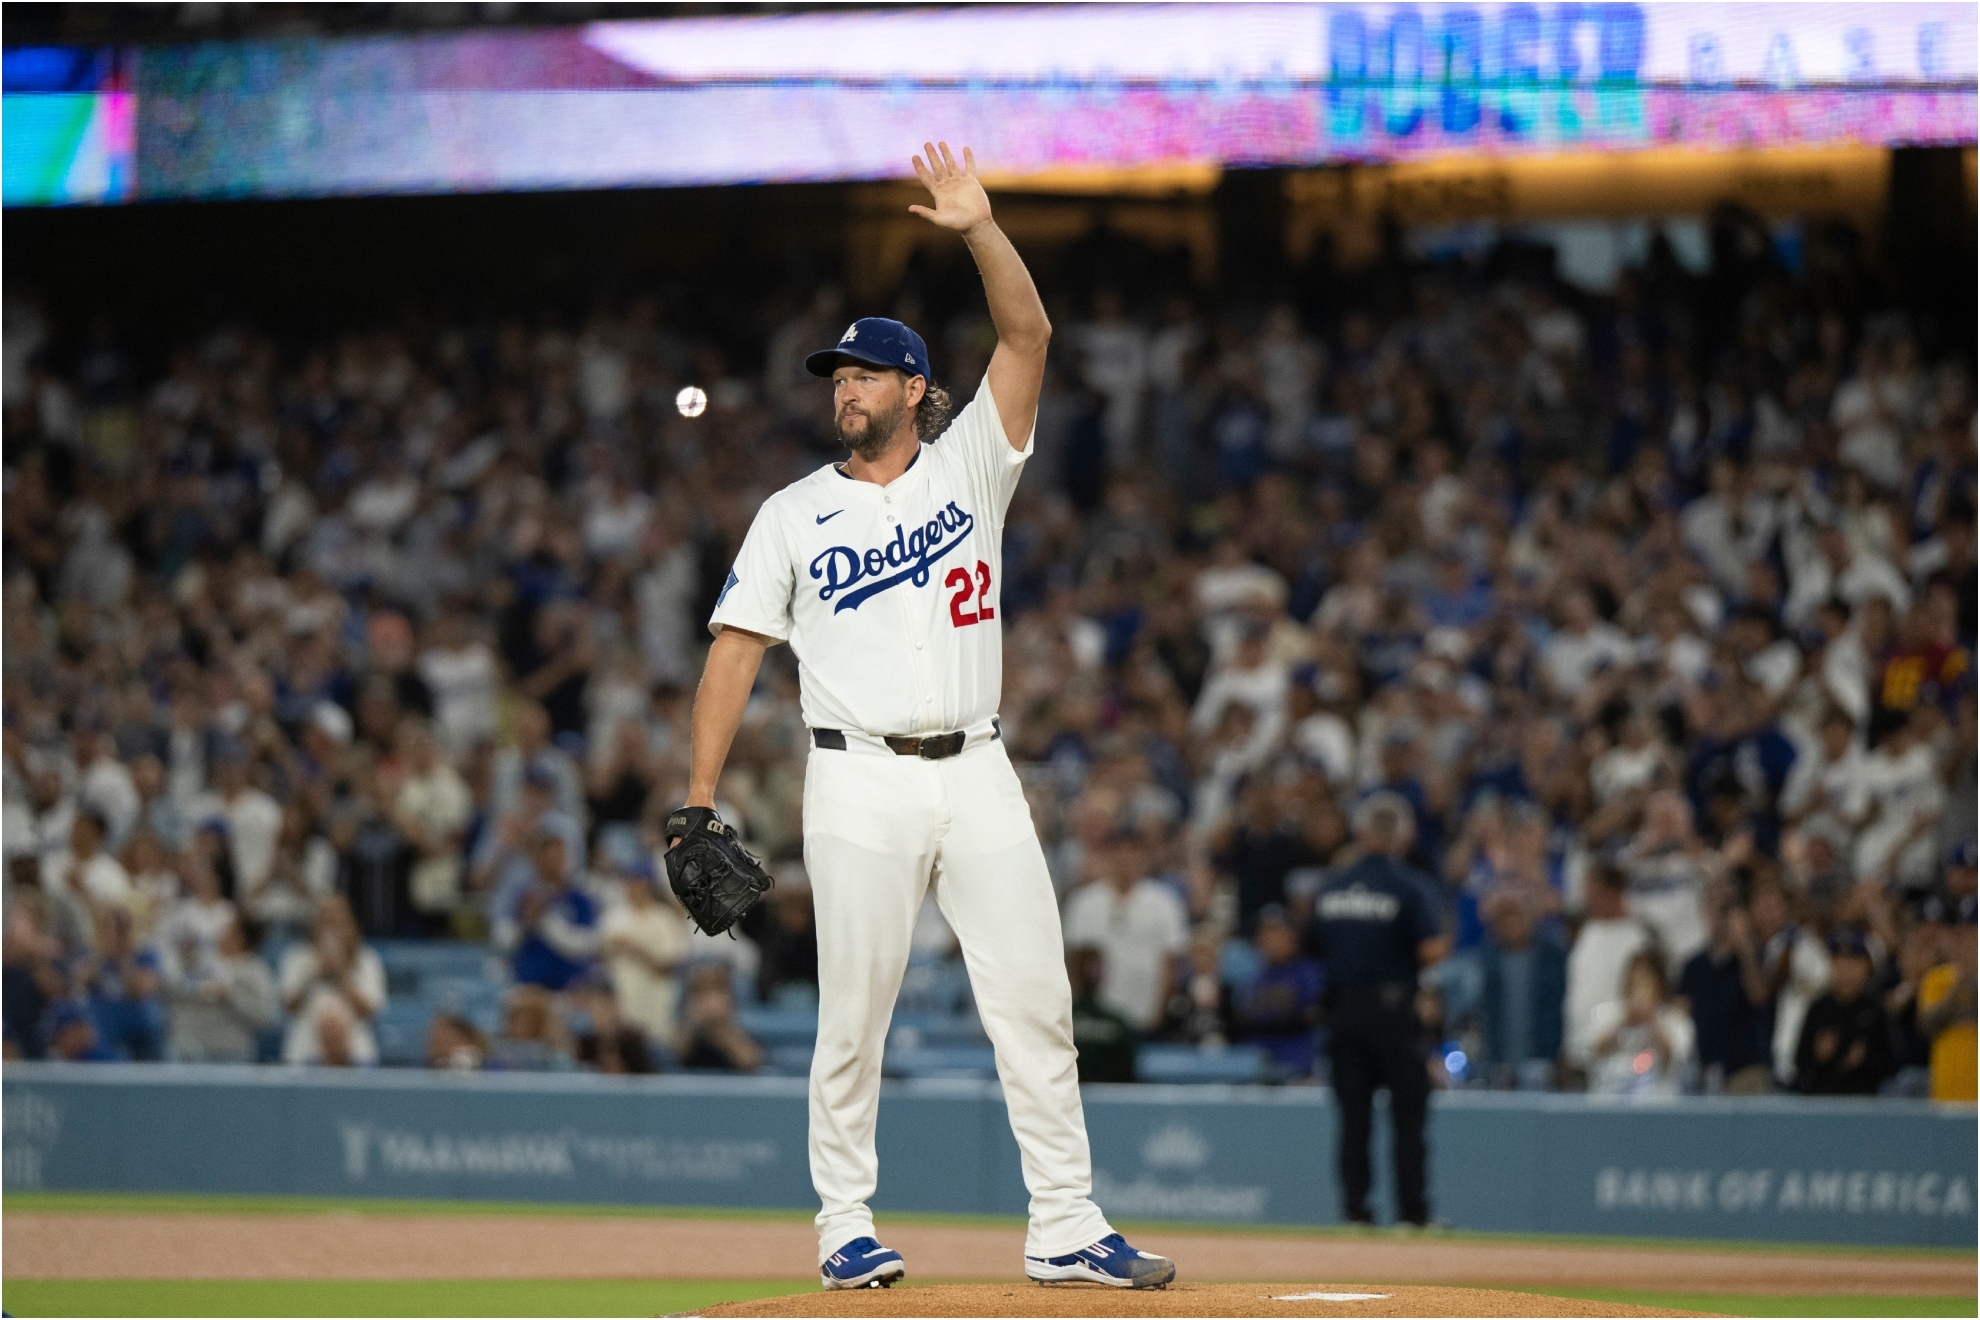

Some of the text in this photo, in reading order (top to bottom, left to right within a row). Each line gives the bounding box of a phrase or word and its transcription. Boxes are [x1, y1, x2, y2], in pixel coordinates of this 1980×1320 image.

[840, 323, 858, 343] LA
[810, 501, 974, 615] Dodgers
[945, 560, 994, 628] 22
[1595, 1168, 1972, 1219] BANK OF AMERICA
